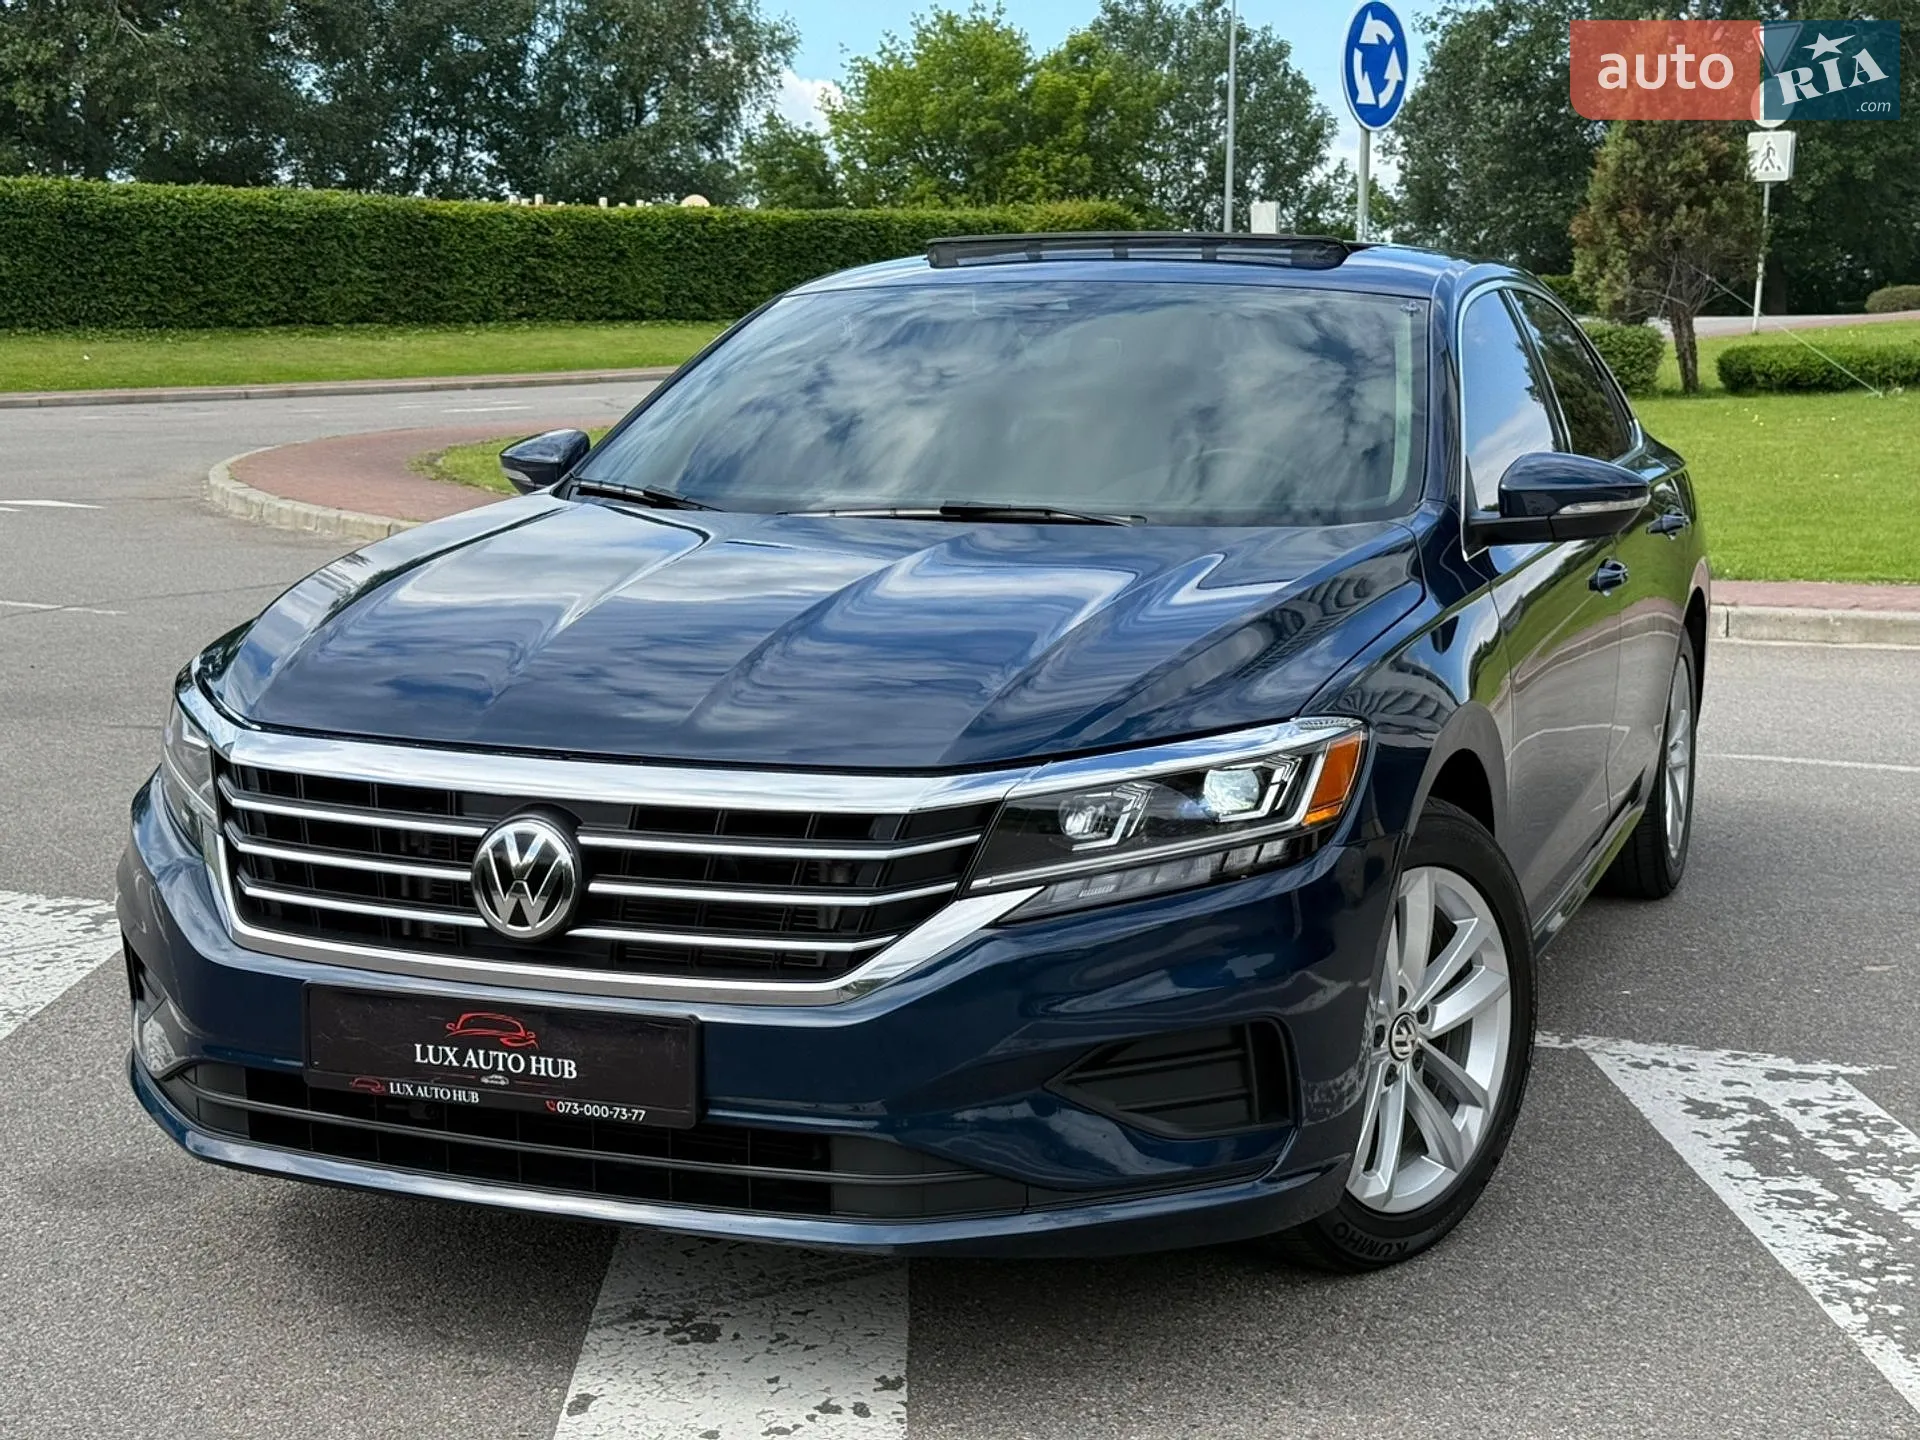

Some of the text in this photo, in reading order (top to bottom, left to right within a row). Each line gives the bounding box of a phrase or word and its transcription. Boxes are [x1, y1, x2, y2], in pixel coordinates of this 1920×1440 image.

[414, 1043, 578, 1079] LUX AUTO HUB
[389, 1082, 479, 1103] LUX AUTO HUB
[556, 1100, 646, 1121] 073-000-73-77
[1332, 1221, 1409, 1257] KUMHO
